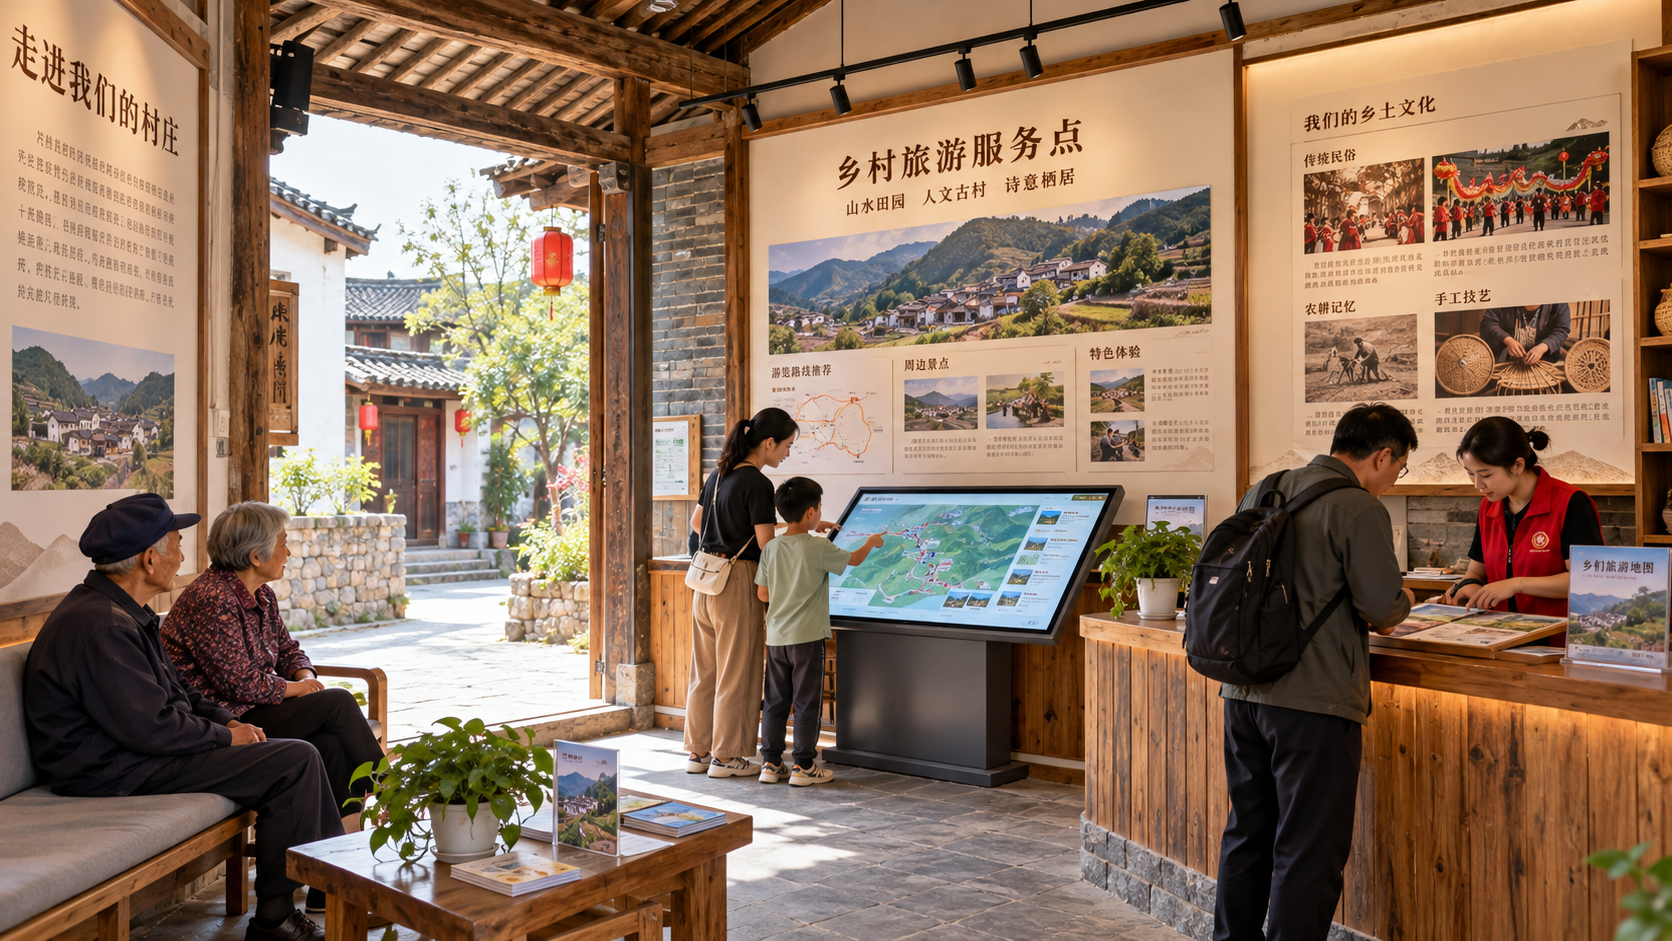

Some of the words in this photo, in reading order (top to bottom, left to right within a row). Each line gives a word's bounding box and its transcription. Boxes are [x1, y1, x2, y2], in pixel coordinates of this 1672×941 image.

[11, 24, 179, 157] 走进我们的村庄
[1304, 95, 1436, 132] 我们的乡土文化
[837, 118, 1083, 190] 乡村旅游服务点
[846, 193, 905, 216] 山水田园
[922, 181, 987, 206] 人文古村
[1005, 167, 1075, 194] 诗意栖居
[1434, 288, 1491, 306] 手工技艺
[1089, 344, 1141, 361] 特色体验
